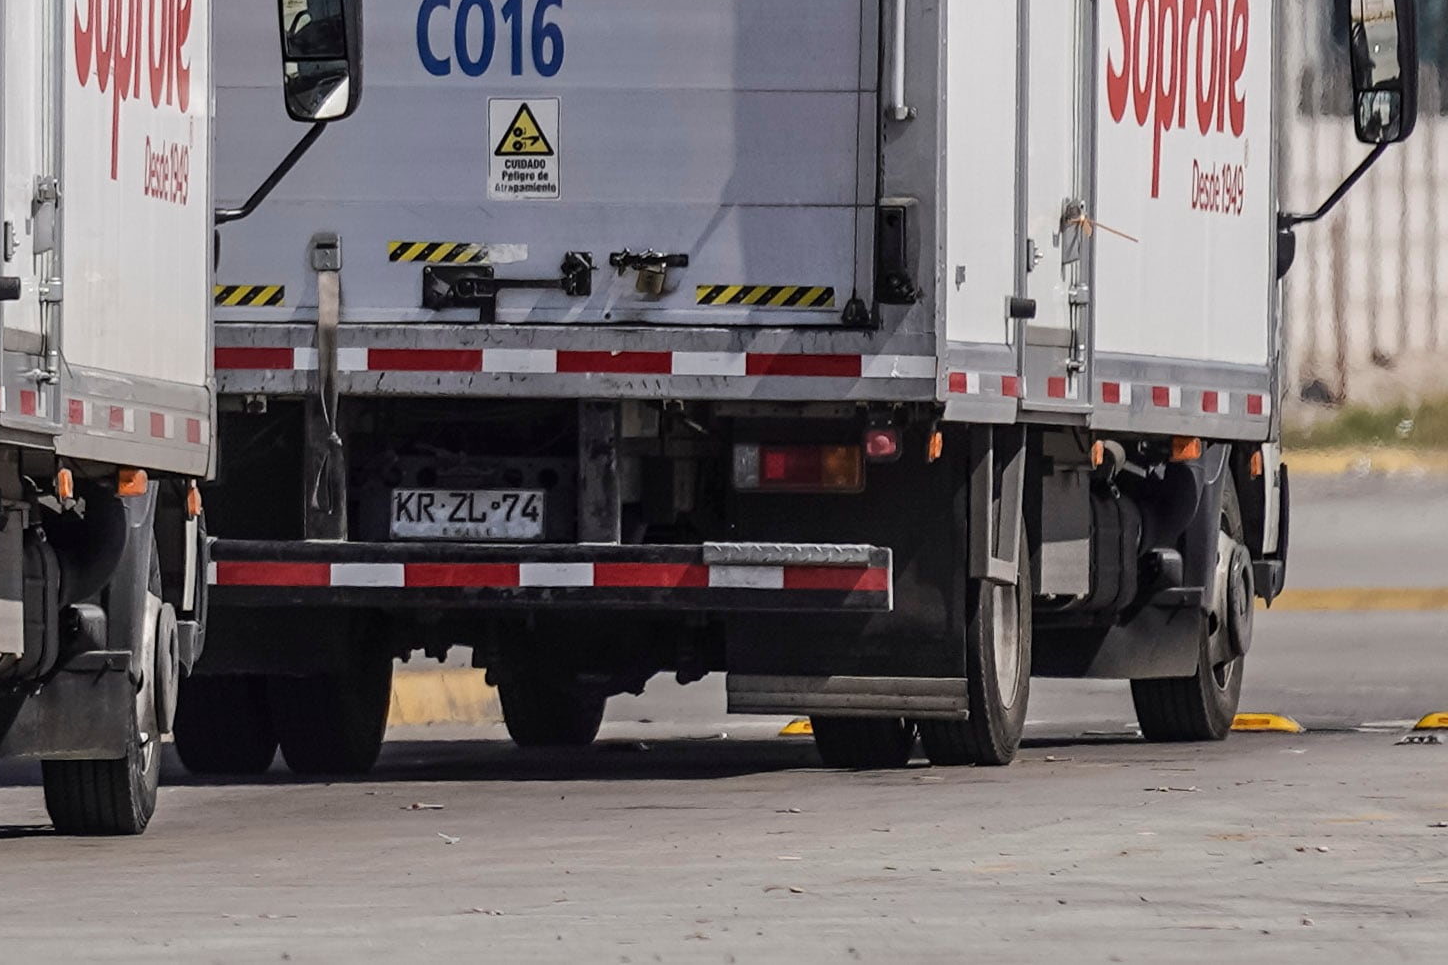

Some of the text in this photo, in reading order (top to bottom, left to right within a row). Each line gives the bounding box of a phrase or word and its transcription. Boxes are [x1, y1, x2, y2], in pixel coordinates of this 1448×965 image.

[143, 135, 190, 206] Desde 1949
[504, 158, 546, 170] CUIDADO
[501, 170, 549, 183] Peligro de
[495, 182, 557, 194] Atrapamiento
[1191, 158, 1245, 216] Desde 1949
